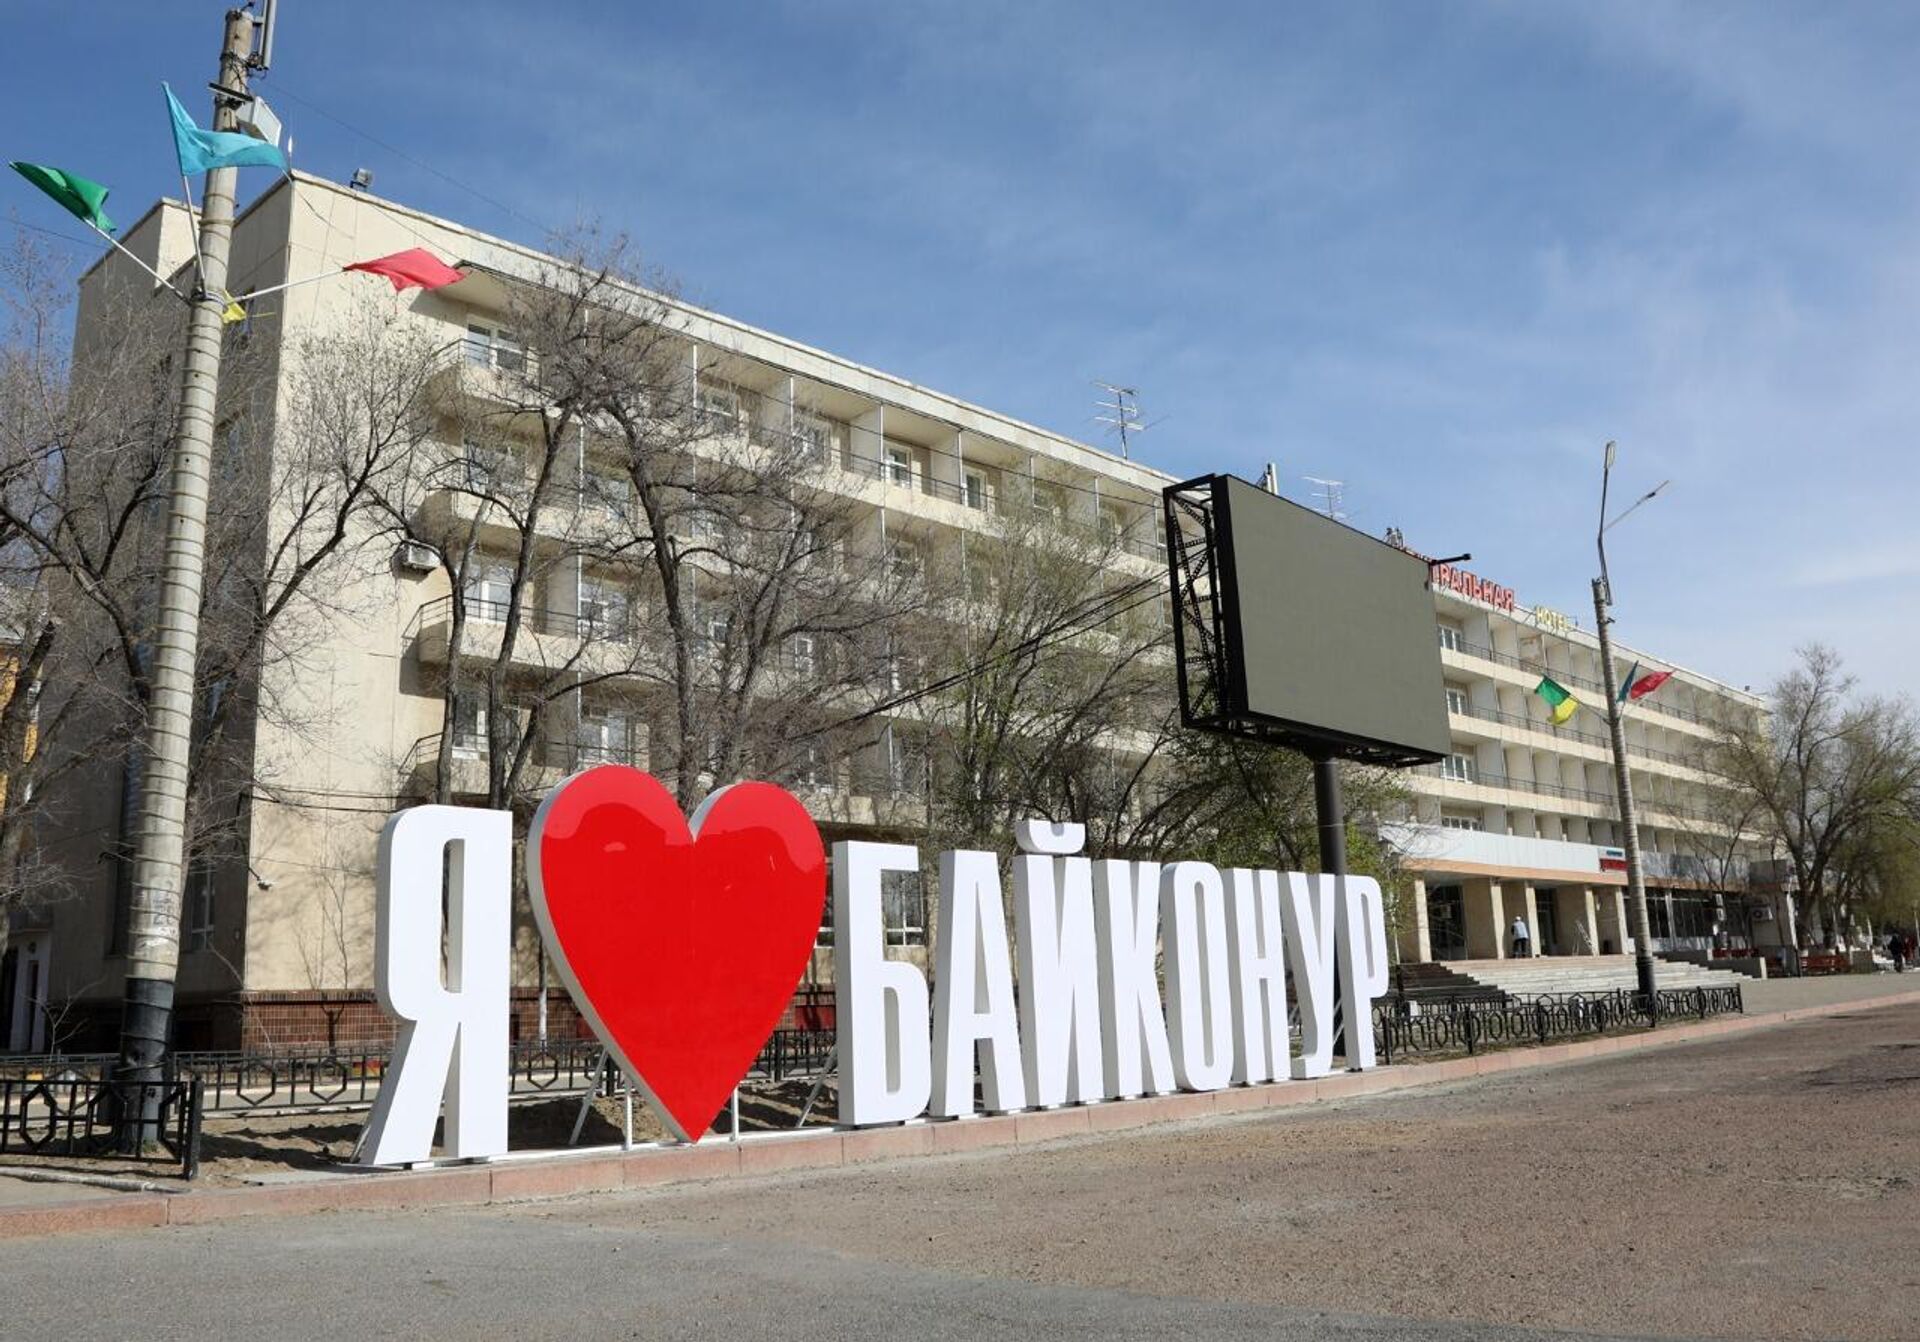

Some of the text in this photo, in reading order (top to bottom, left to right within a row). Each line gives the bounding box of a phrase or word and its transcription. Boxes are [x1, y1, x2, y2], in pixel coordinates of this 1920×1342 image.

[1535, 605, 1569, 630] HOTEL
[360, 804, 1389, 1165] Я БАЙКОНУР
